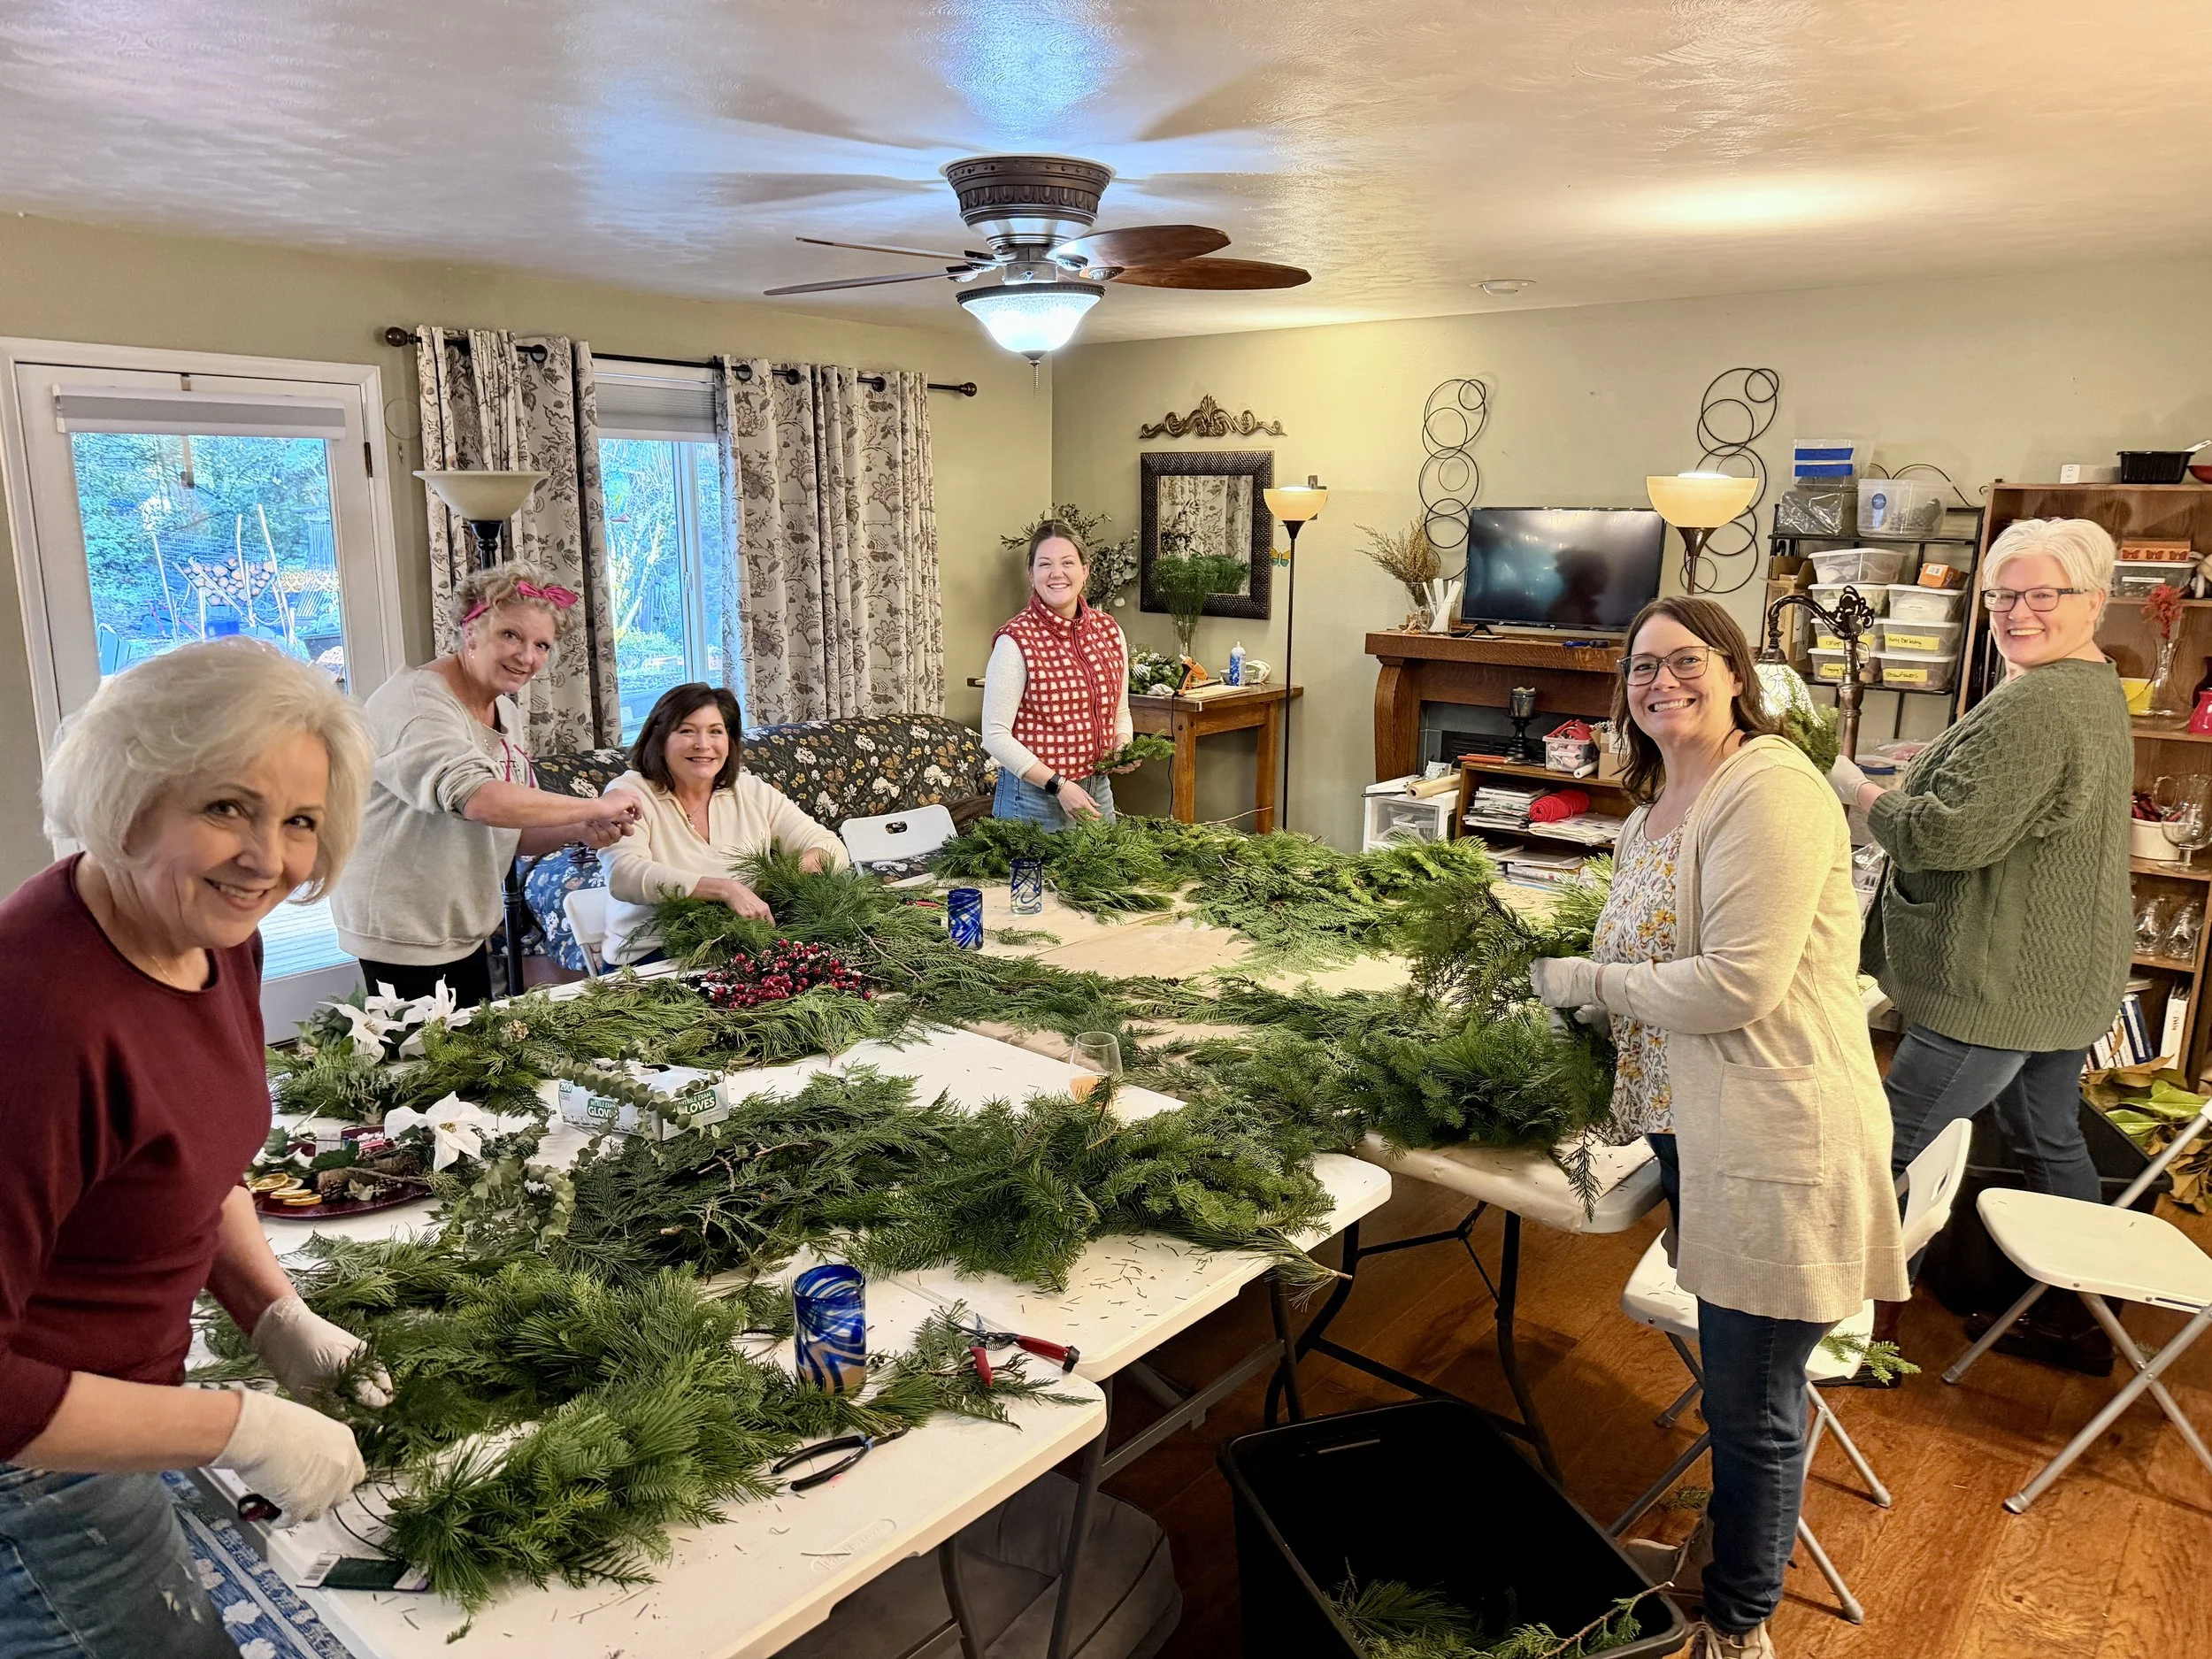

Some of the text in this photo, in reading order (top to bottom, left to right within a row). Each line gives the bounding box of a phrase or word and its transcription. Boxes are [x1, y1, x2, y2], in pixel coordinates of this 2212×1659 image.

[560, 1082, 572, 1092] 200
[697, 1092, 710, 1101] EXAM
[677, 1097, 716, 1115] LOVES
